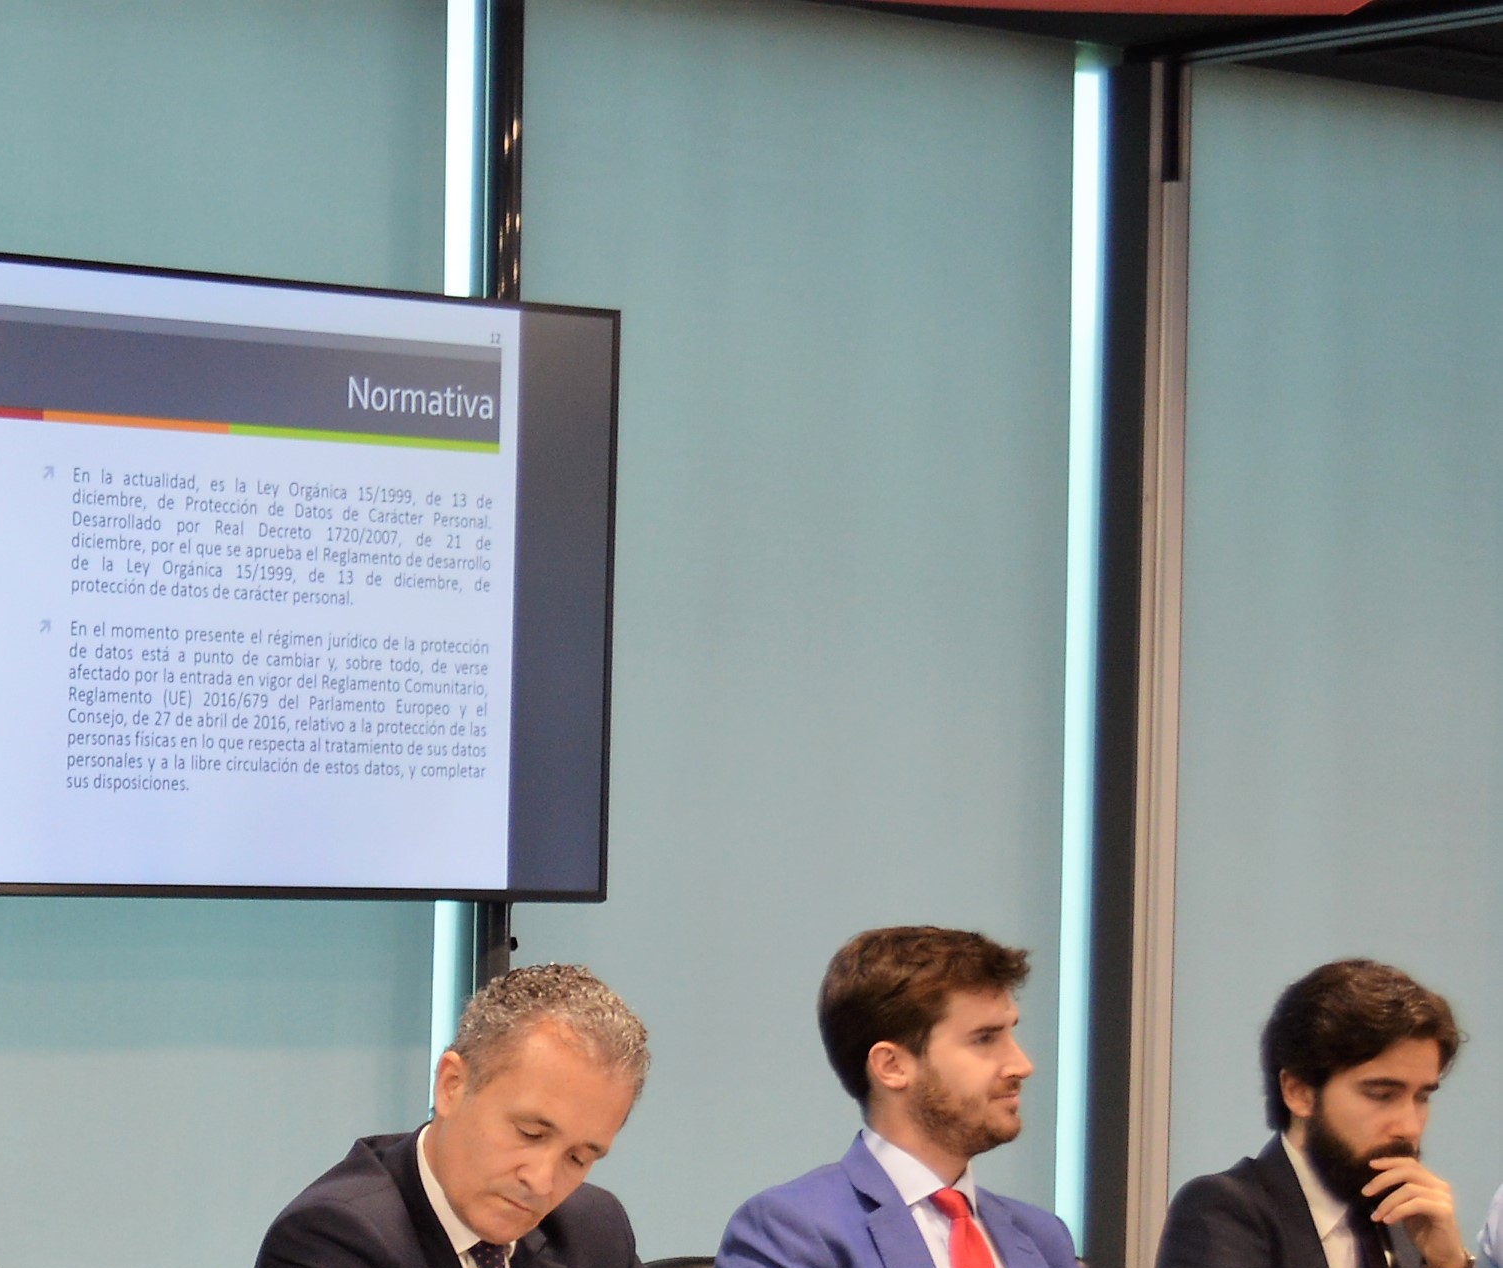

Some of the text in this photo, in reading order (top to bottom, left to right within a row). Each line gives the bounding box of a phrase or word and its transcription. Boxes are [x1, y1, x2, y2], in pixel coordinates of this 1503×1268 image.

[347, 376, 494, 420] Normativa
[71, 487, 492, 530] diciembre, de Protección de Datos de Carácter Personal.
[72, 466, 494, 510] En la actualidad, es la Ley Orgánica 15/1999, de 13 de
[66, 752, 488, 781] personales y a la libre circulación de estos datos, y completar
[66, 774, 190, 794] sus disposiciones.
